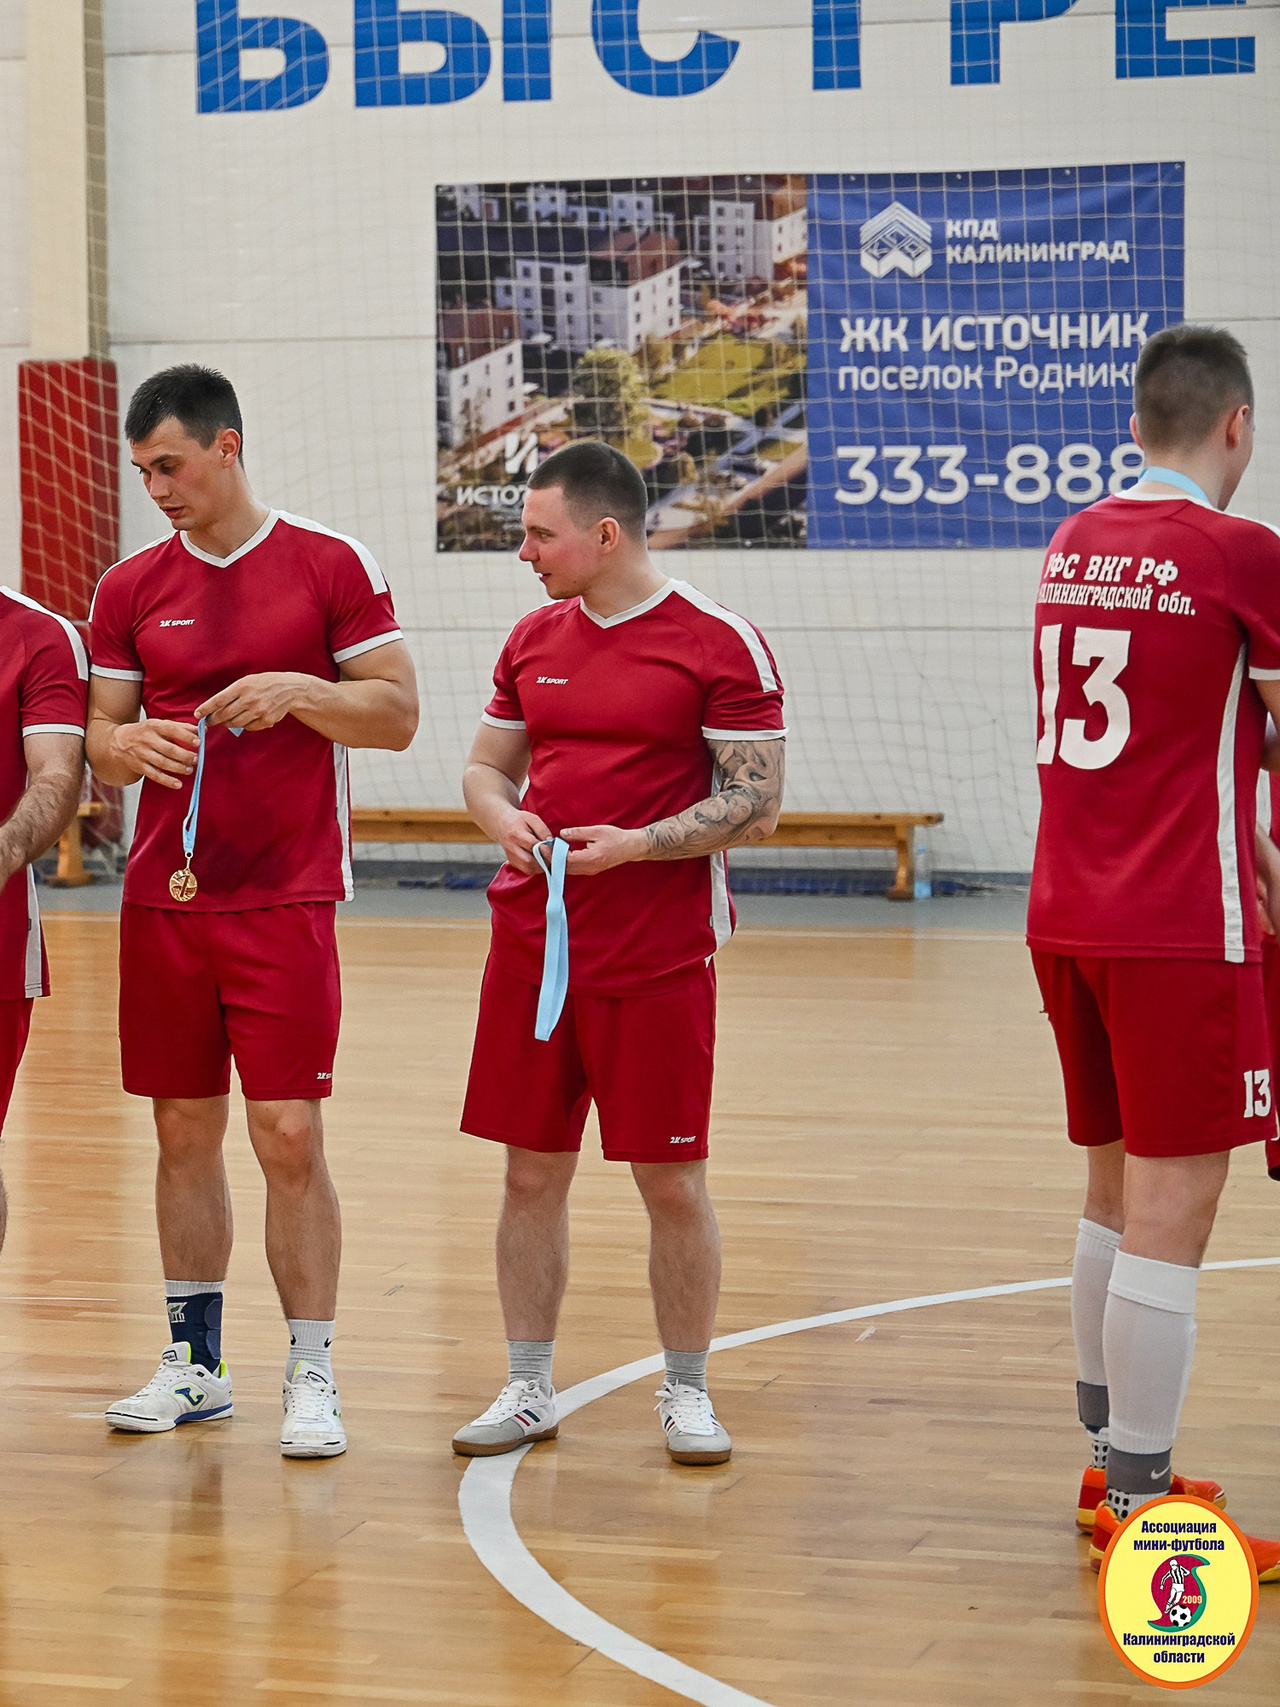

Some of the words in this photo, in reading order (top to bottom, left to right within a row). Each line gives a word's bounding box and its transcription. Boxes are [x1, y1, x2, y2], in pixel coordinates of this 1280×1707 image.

[946, 218, 1000, 241] КПД
[946, 239, 1130, 264] КАЛИНИНГРАД
[839, 316, 910, 352] ЖК
[921, 311, 1149, 351] ИСТОЧНИК
[838, 364, 984, 391] поселок
[1135, 557, 1179, 586] РФ
[1036, 623, 1132, 771] 13
[1243, 1067, 1272, 1118] 13
